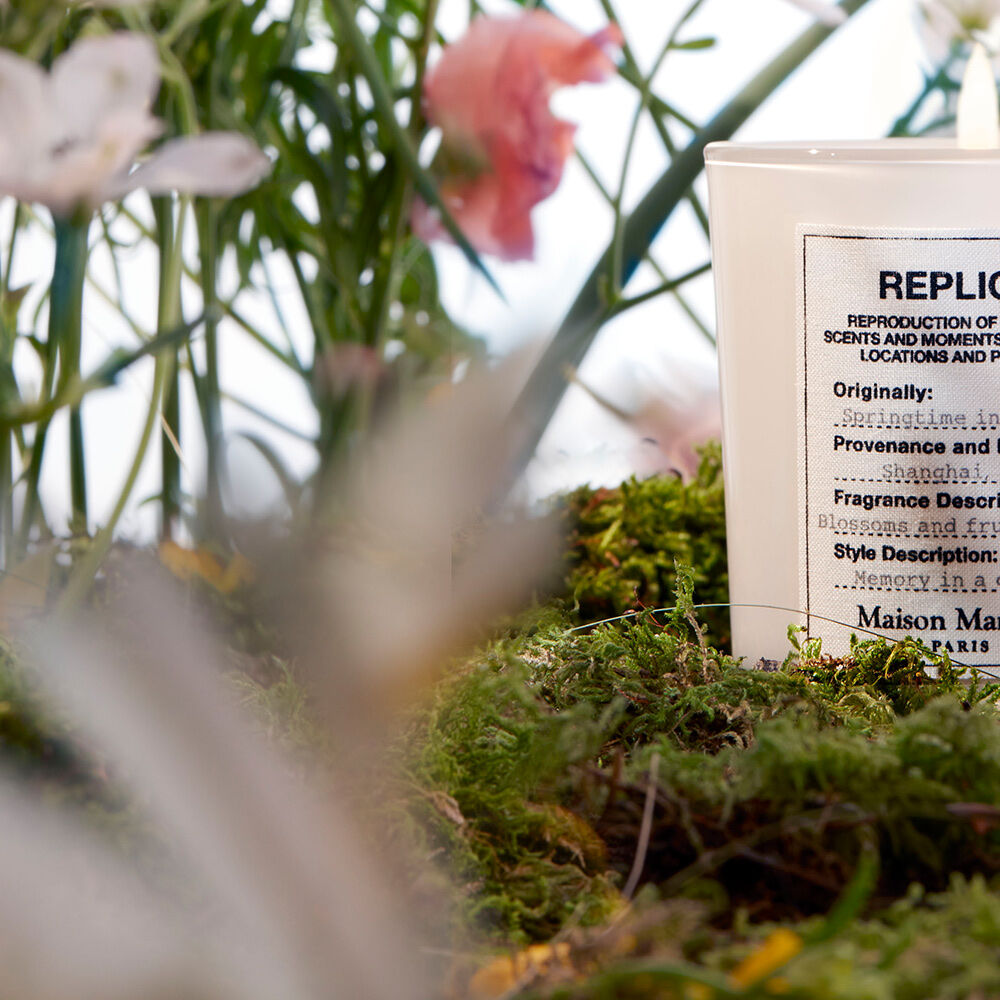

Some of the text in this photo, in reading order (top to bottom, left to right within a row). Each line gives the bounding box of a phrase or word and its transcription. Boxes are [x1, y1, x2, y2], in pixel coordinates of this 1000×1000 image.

[847, 314, 971, 330] REPRODUCTION
[976, 315, 998, 329] OF
[823, 330, 881, 346] SCENTS
[884, 333, 918, 346] AND
[860, 349, 949, 364] LOCATIONS
[951, 349, 986, 363] AND
[833, 381, 933, 403] Originally:
[842, 407, 967, 428] Springtime
[977, 409, 1000, 425] in
[833, 436, 946, 454] Provenance
[952, 437, 990, 454] and
[882, 462, 990, 483] Shanghai,
[833, 489, 930, 511] Fragrance
[818, 513, 908, 532] Blossoms
[918, 517, 956, 534] and
[833, 543, 998, 566] Style Description:
[854, 570, 930, 590] Memory
[939, 570, 965, 588] in
[974, 574, 986, 588] a
[857, 604, 946, 631] Maison
[932, 639, 990, 653] PARIS
